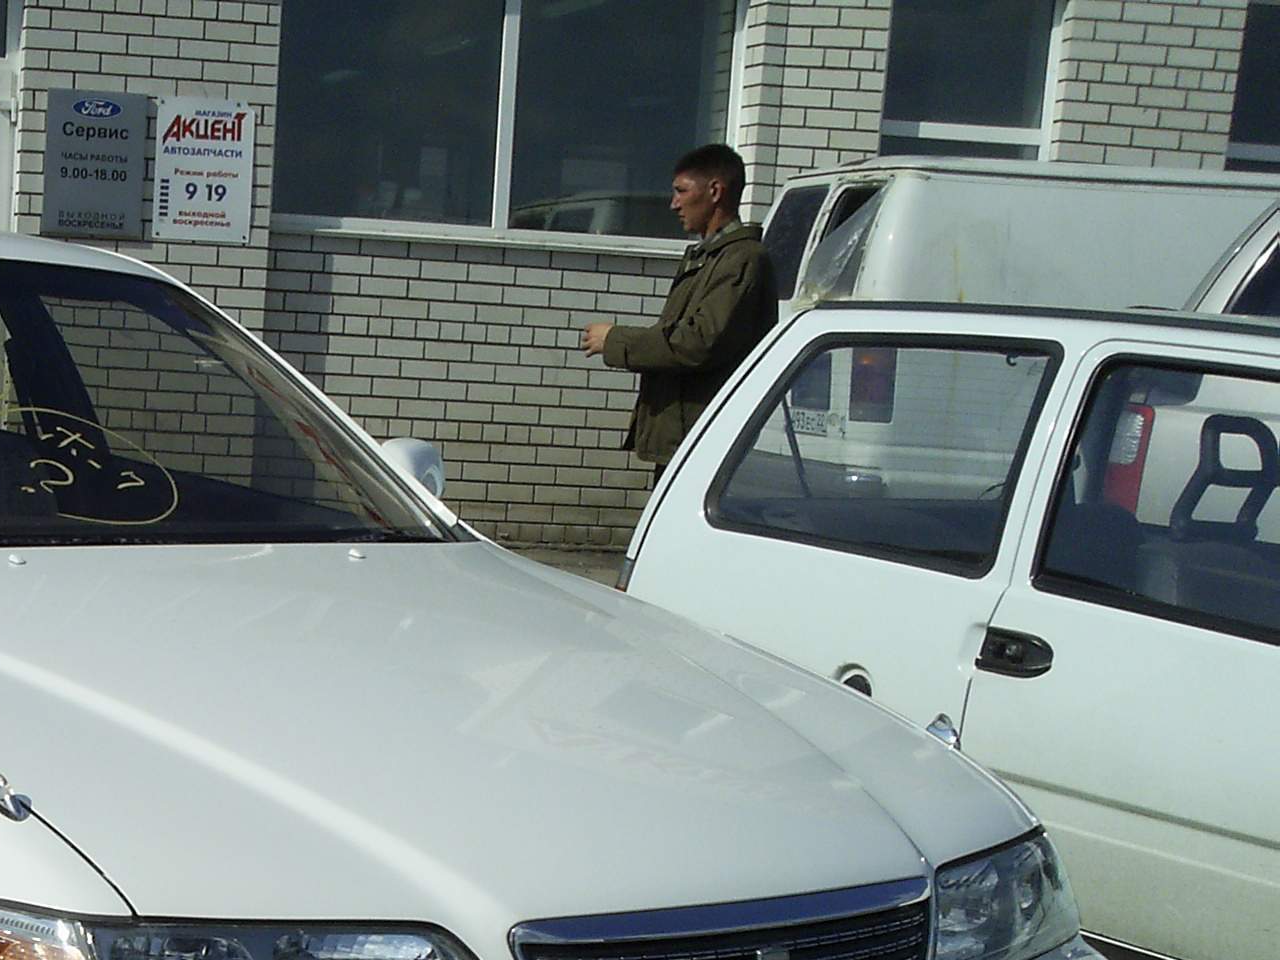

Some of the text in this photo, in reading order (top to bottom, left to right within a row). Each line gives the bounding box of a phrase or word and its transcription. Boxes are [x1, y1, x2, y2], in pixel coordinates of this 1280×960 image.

[81, 101, 113, 116] Ford
[195, 110, 232, 118] МАГАЗИН
[62, 121, 129, 141] Сервис
[162, 112, 247, 145] АКЦЕНТ
[61, 152, 128, 163] ЧАСЫ РАБОТЫ
[163, 146, 242, 158] АВТОЗАПЧАСТИ
[60, 166, 127, 182] 9.00-18.00
[174, 168, 239, 178] Режим работы
[185, 183, 227, 202] 9 19
